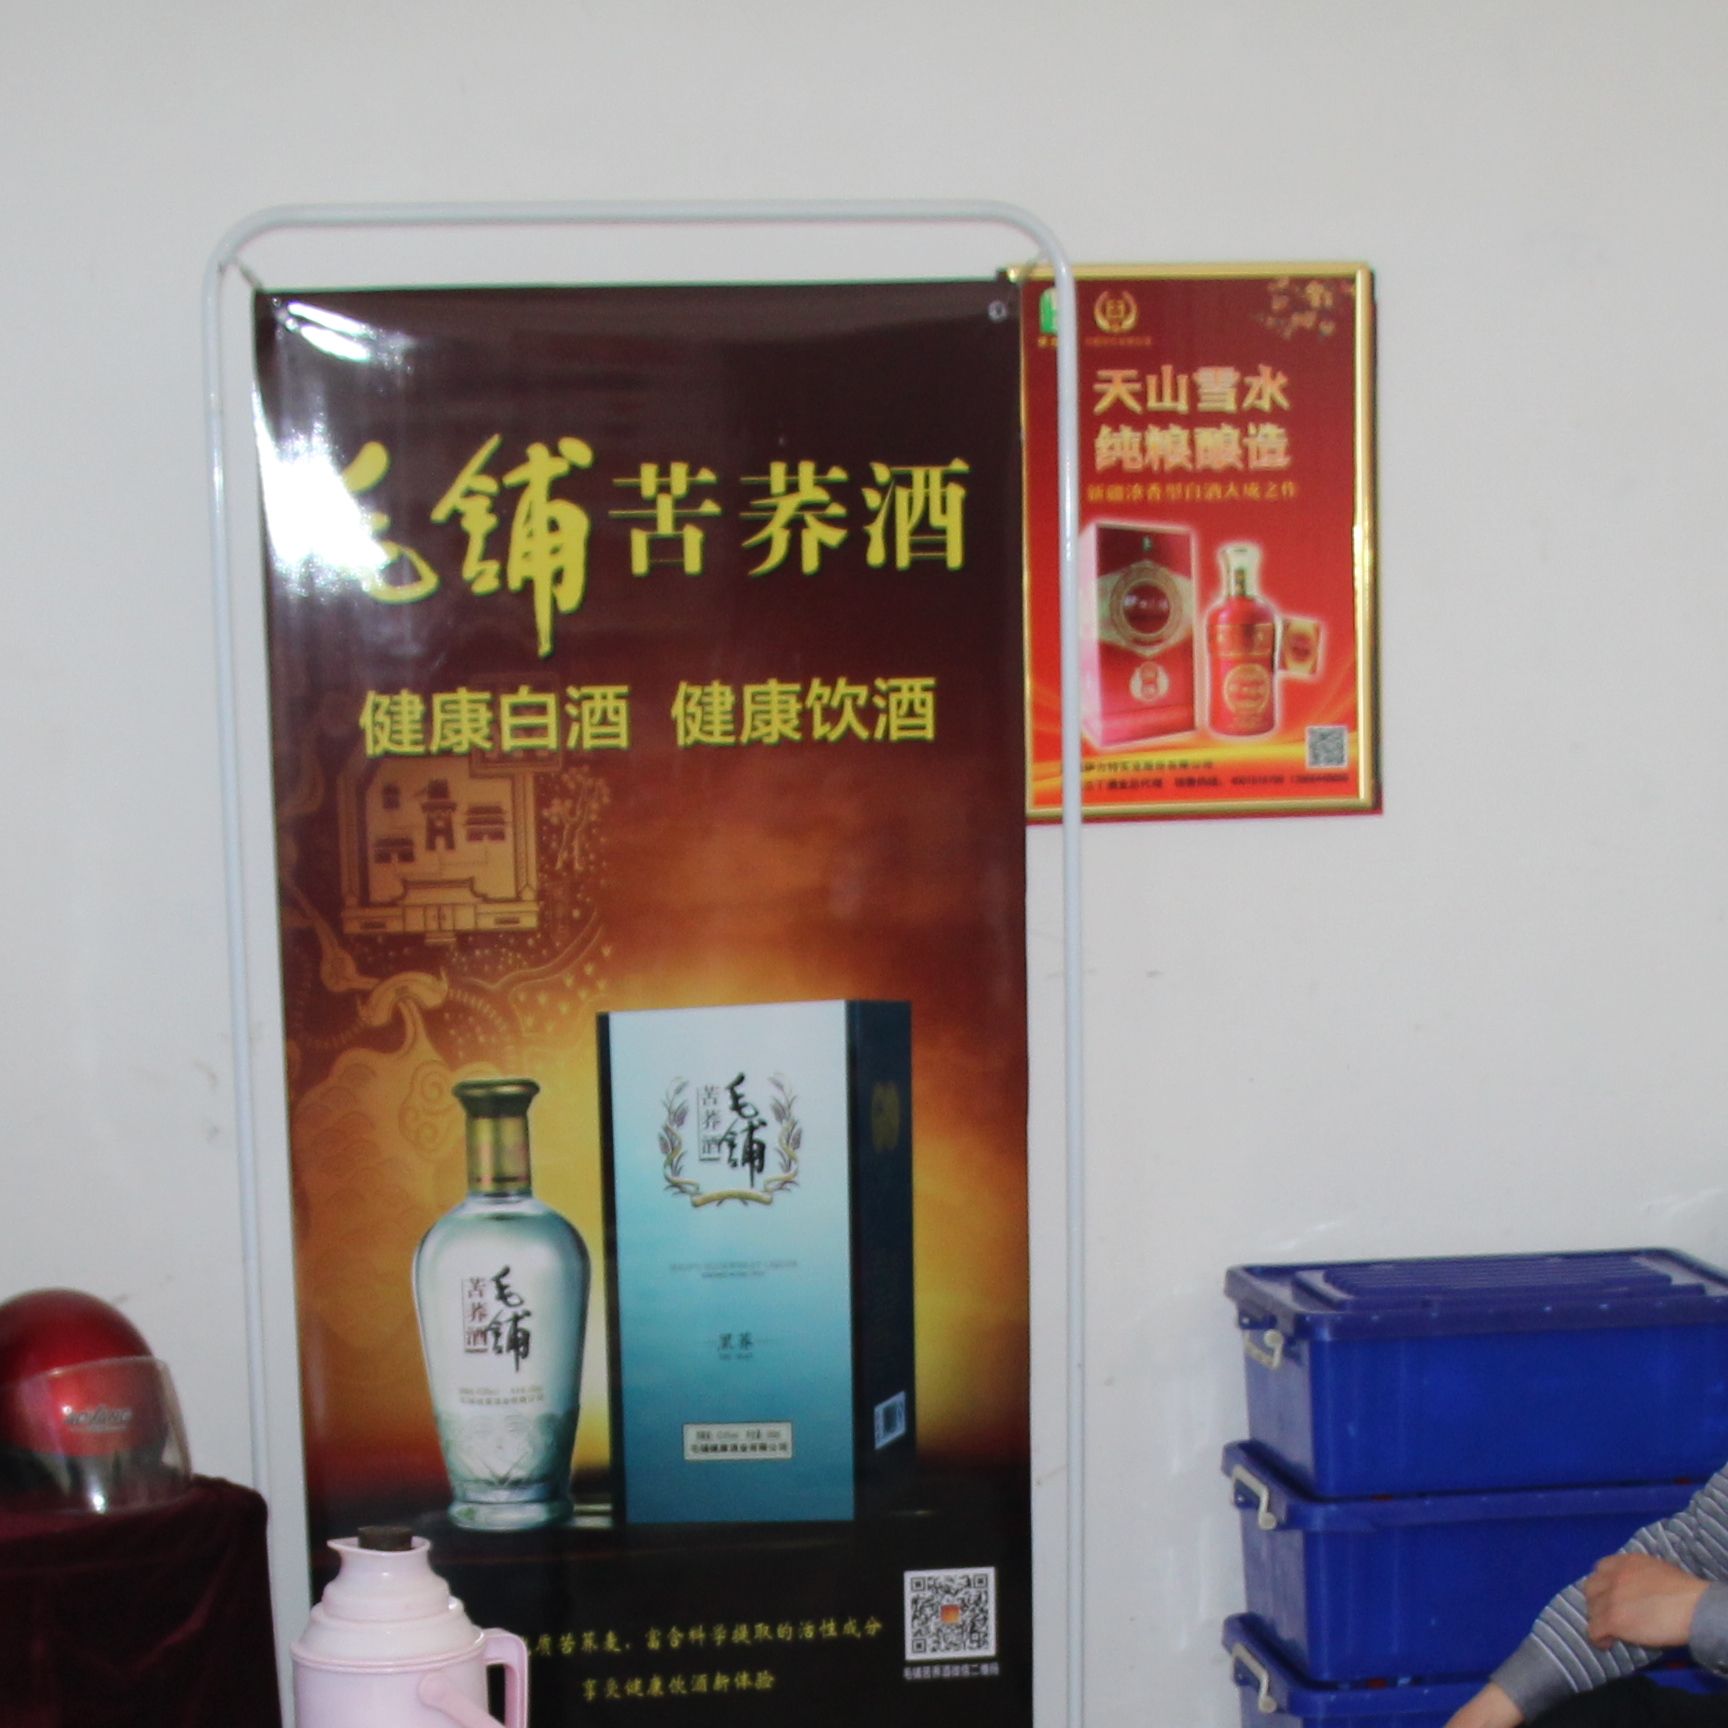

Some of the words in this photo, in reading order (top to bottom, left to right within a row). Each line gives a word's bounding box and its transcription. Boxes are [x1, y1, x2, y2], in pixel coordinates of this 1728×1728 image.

[1094, 365, 1290, 413] 天山雪水
[1094, 422, 1292, 473] 纯粮酿造
[359, 685, 629, 758] 健康白酒
[671, 677, 937, 746] 健康饮酒
[581, 1670, 776, 1702] 享受健康饮酒新体验
